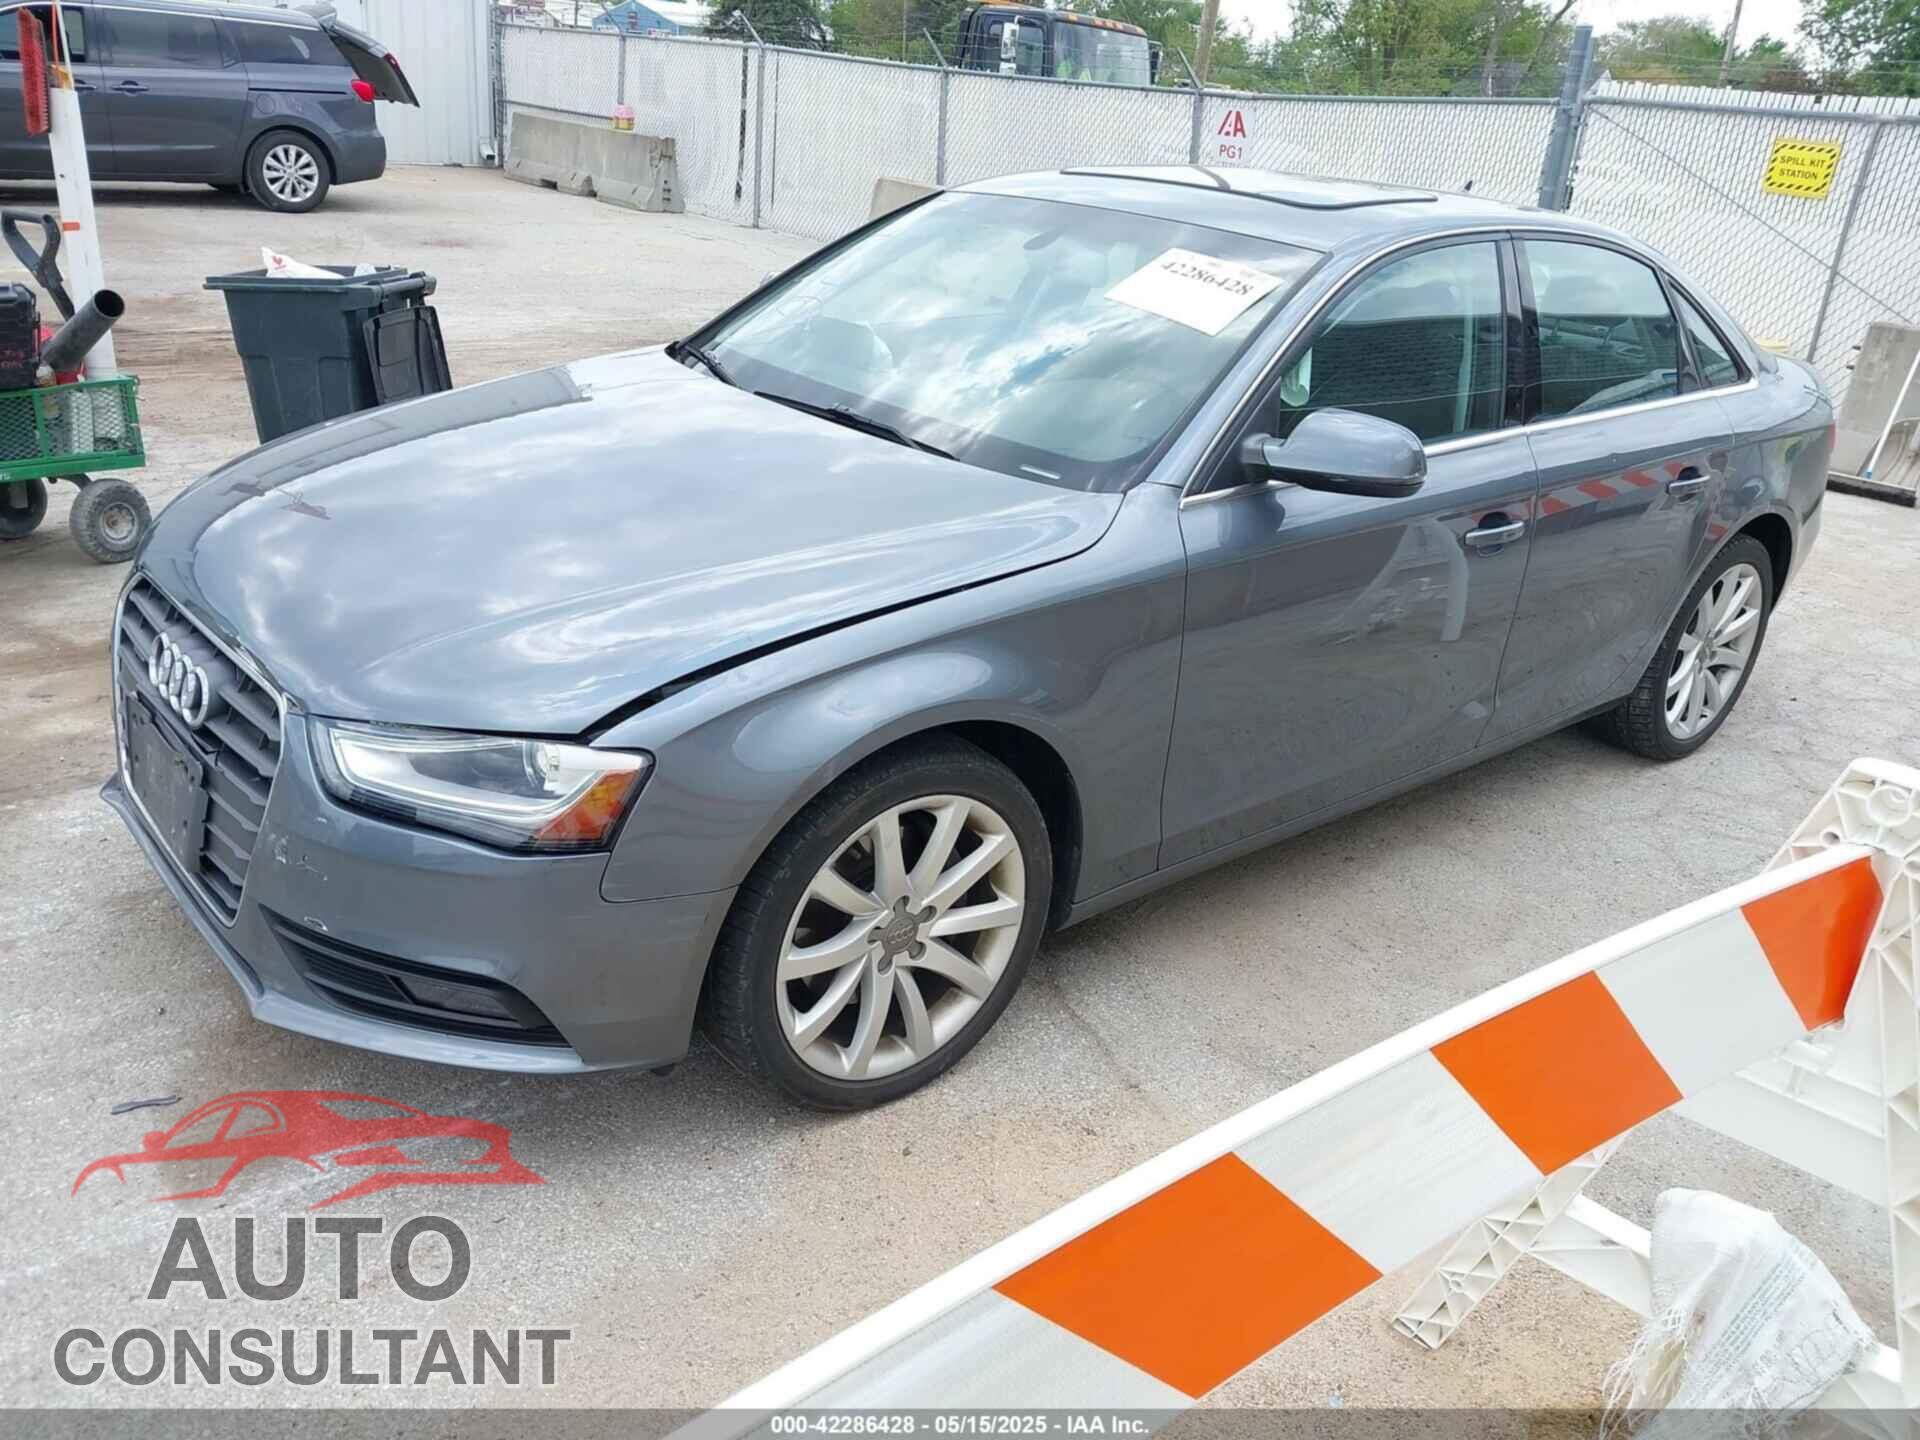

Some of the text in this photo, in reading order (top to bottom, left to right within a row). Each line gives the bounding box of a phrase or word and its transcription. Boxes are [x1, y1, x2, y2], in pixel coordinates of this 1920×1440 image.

[1219, 144, 1242, 160] PG1
[1780, 156, 1826, 169] SPILL KIT
[1780, 168, 1817, 180] STATION
[1161, 262, 1253, 295] 42286428
